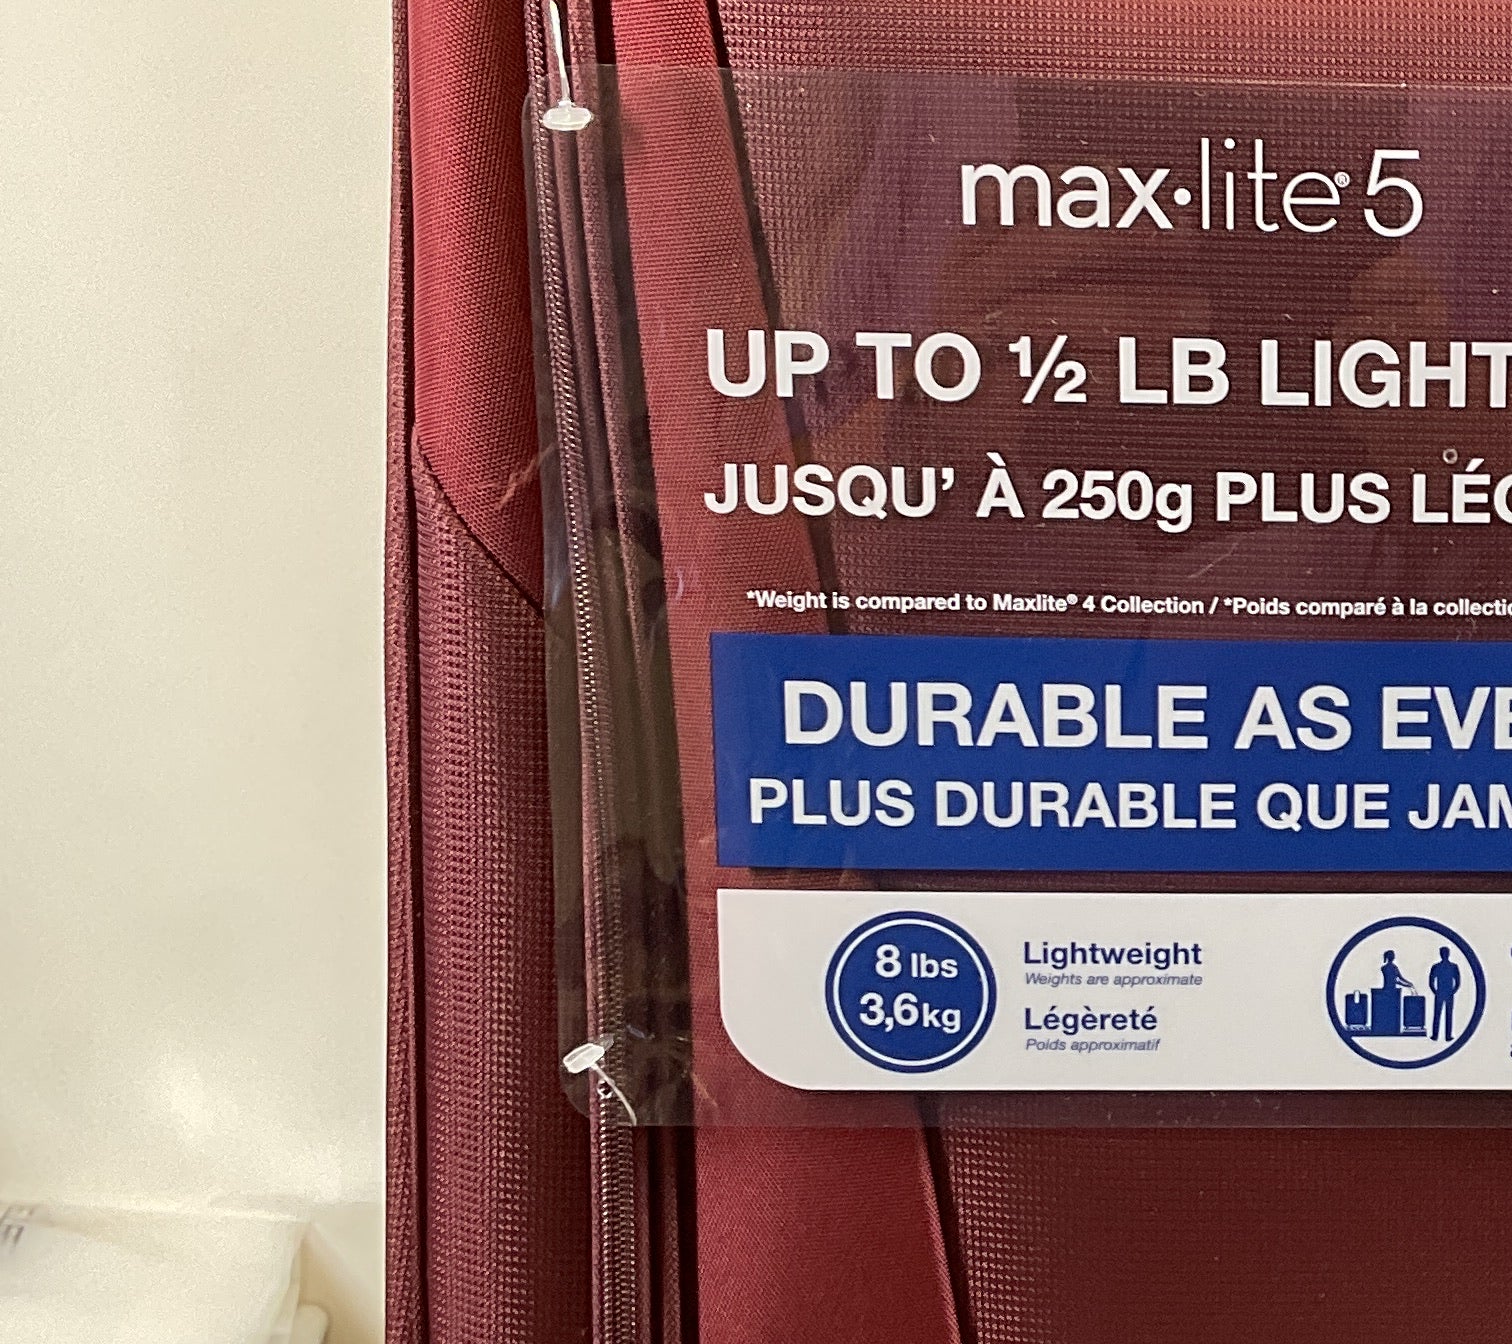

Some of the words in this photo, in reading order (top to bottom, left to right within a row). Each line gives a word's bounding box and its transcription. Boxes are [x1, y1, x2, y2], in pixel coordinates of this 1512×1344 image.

[1364, 149, 1424, 238] 5
[706, 328, 829, 399] UP
[855, 332, 981, 402] TO
[1118, 337, 1230, 405] LB
[976, 453, 1026, 519] À
[1042, 470, 1193, 534] 250g
[1216, 471, 1391, 524] PLUS
[832, 592, 849, 610] is
[855, 593, 960, 617] compared
[965, 594, 987, 612] to
[1082, 595, 1095, 612] 4
[1101, 595, 1204, 615] Collection
[1296, 597, 1386, 620] comparé
[1392, 598, 1404, 616] à
[1410, 599, 1428, 616] la
[783, 680, 1208, 749] DURABLE
[1234, 685, 1352, 751] AS
[749, 778, 915, 827] PLUS
[936, 781, 1236, 830] DURABLE
[1256, 783, 1390, 832] QUE
[875, 943, 902, 978] 8
[911, 953, 958, 978] lbs
[1023, 941, 1203, 971] Lightweight
[1025, 973, 1082, 987] Weights
[1086, 974, 1110, 986] are
[1113, 974, 1203, 988] approximate
[859, 992, 962, 1033] 3,6kg
[1024, 1005, 1158, 1035] Légèreté
[1025, 1038, 1067, 1051] Poids
[1070, 1038, 1162, 1053] approximatif
